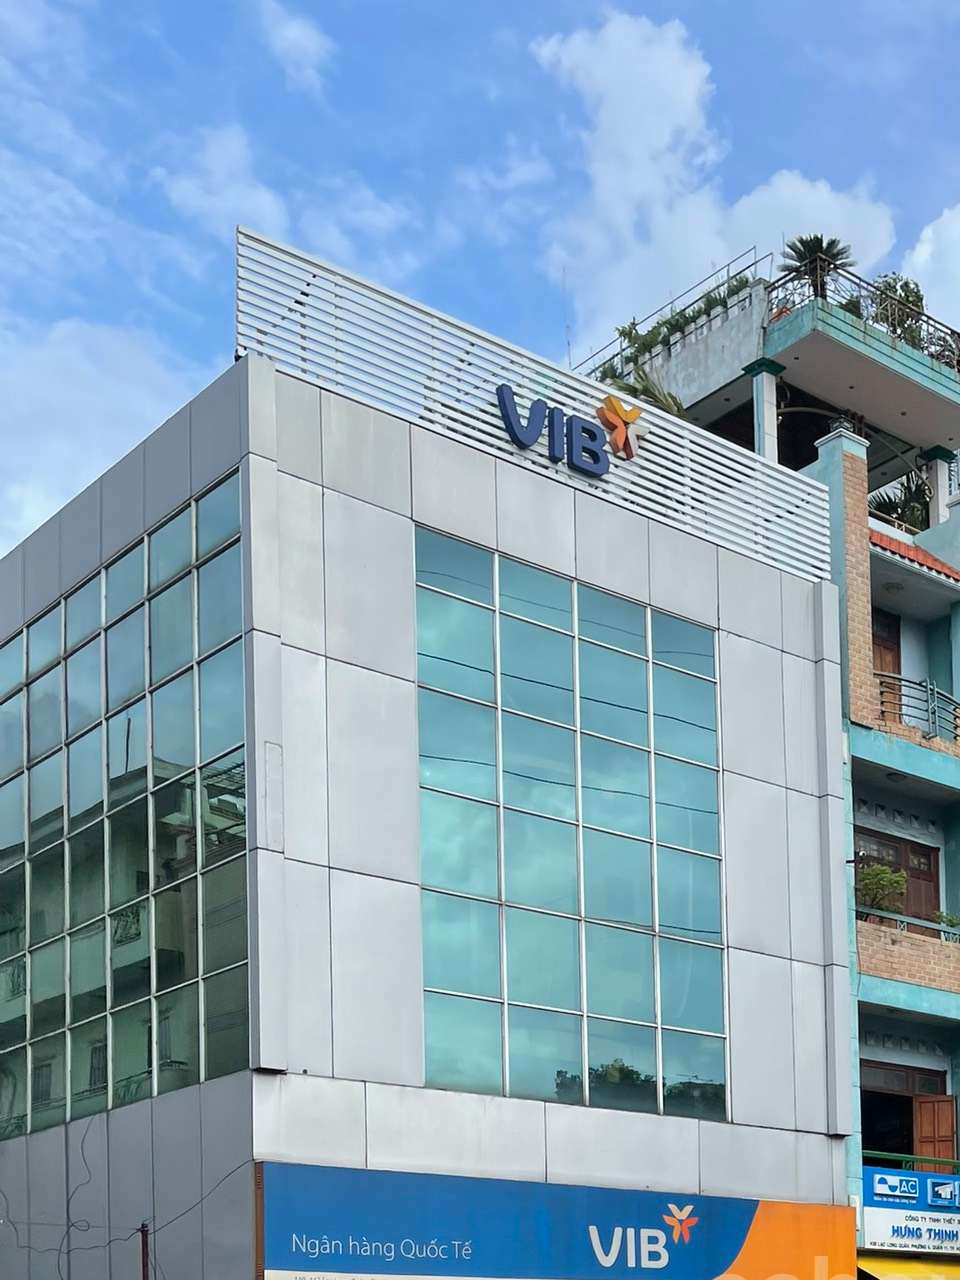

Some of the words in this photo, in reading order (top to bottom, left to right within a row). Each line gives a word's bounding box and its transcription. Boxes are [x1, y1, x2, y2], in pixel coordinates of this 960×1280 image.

[496, 383, 610, 478] VIB
[901, 1181, 916, 1193] AC
[292, 1233, 343, 1259] Ngân
[350, 1236, 395, 1261] hàng
[400, 1238, 448, 1260] Quốc
[451, 1240, 473, 1260] Tế
[588, 1225, 669, 1269] VIB
[891, 1225, 922, 1240] HƯNG
[927, 1228, 958, 1243] THỊNH
